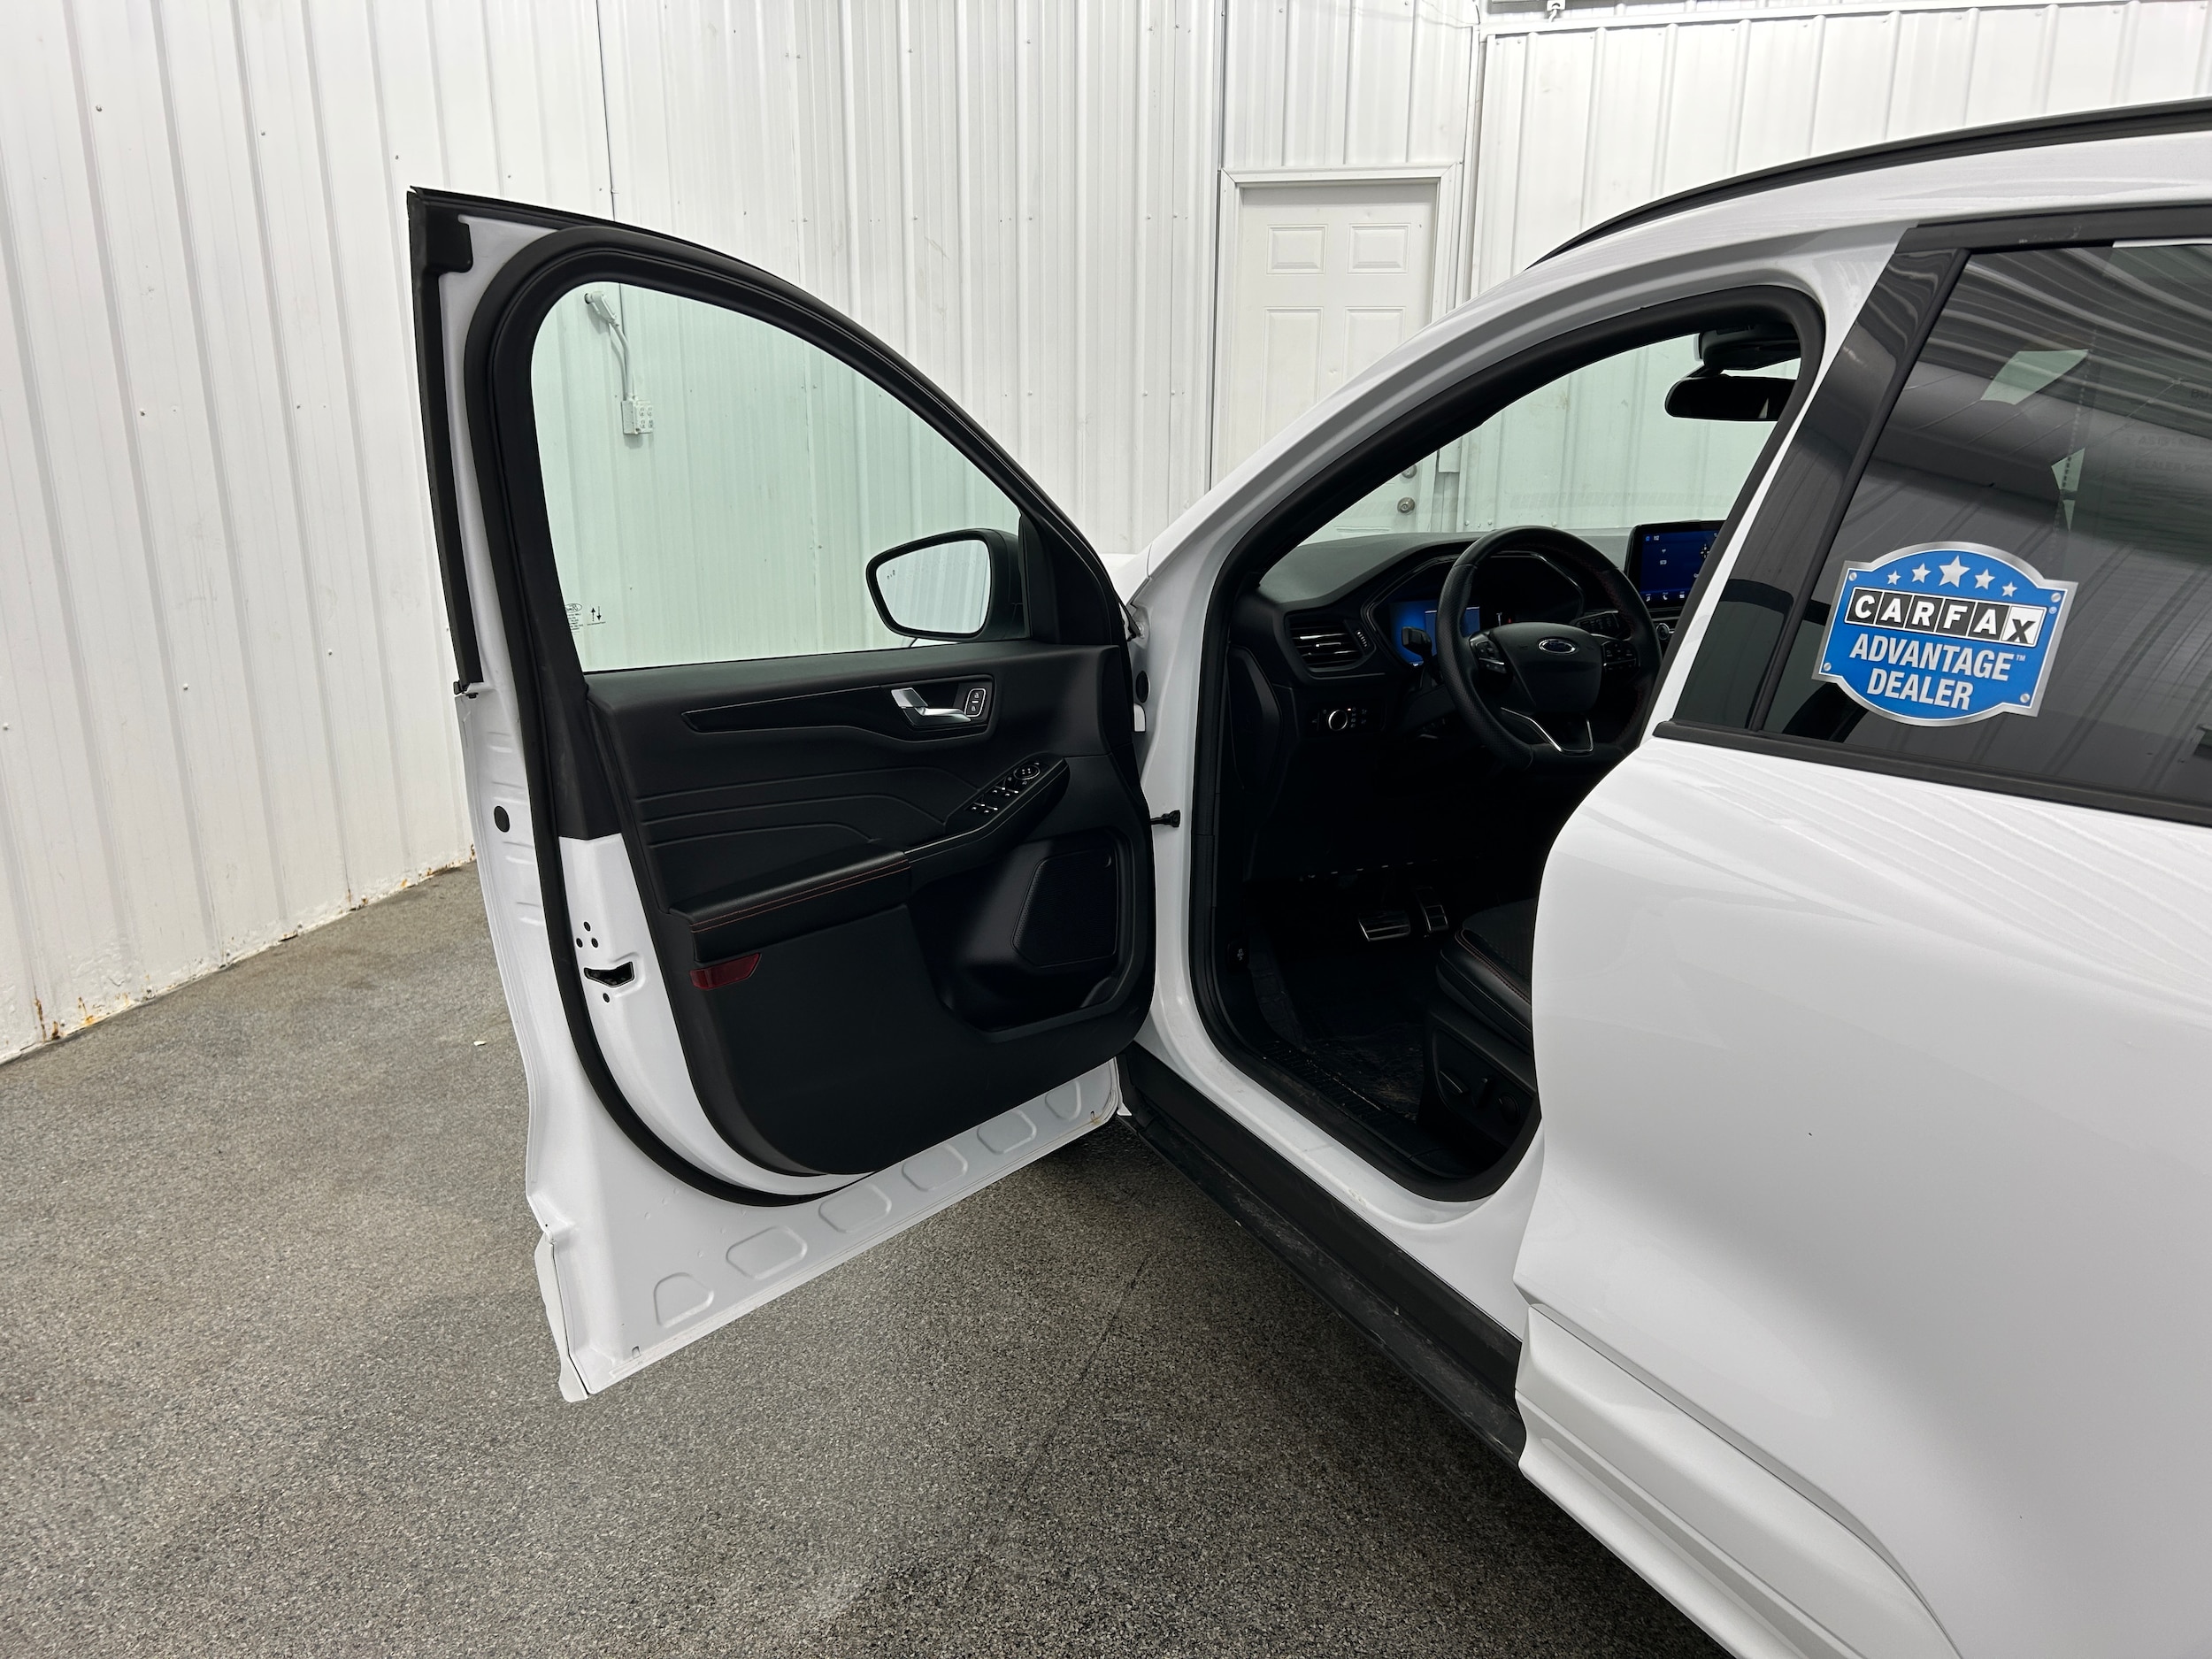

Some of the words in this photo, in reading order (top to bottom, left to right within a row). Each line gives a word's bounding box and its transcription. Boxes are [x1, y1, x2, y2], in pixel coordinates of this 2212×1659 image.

[1855, 594, 2036, 644] CARFAX
[1849, 633, 2015, 681] ADVANTAGE
[1867, 667, 1974, 710] DEALER
